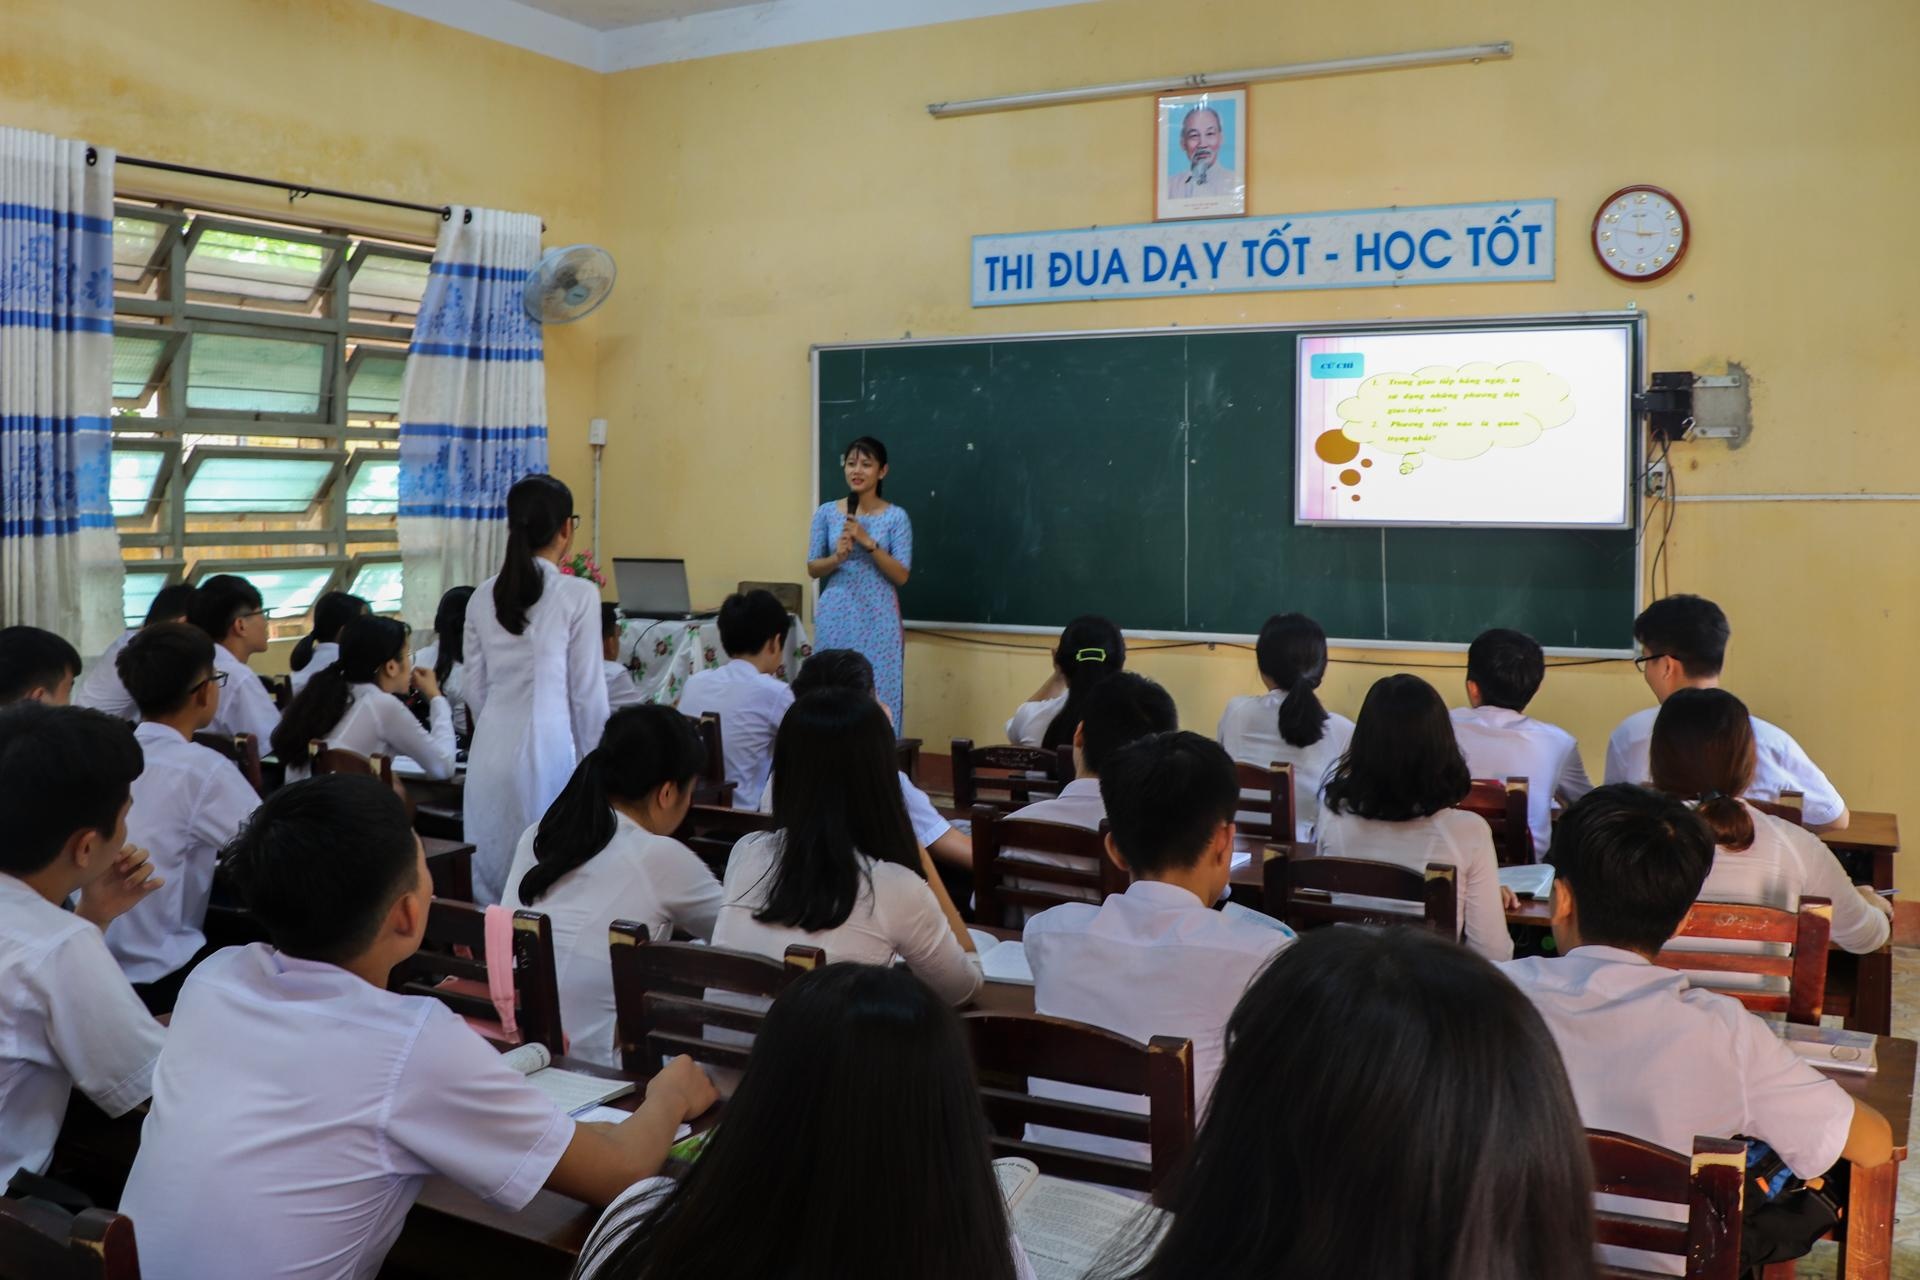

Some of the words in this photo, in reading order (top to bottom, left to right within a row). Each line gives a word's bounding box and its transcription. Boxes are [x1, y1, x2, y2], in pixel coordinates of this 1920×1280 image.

[985, 254, 1033, 292] THI
[1048, 247, 1130, 288] ĐUA
[1142, 241, 1228, 289] DẠY
[1242, 222, 1311, 278] TỐT
[1466, 208, 1543, 267] TỐT
